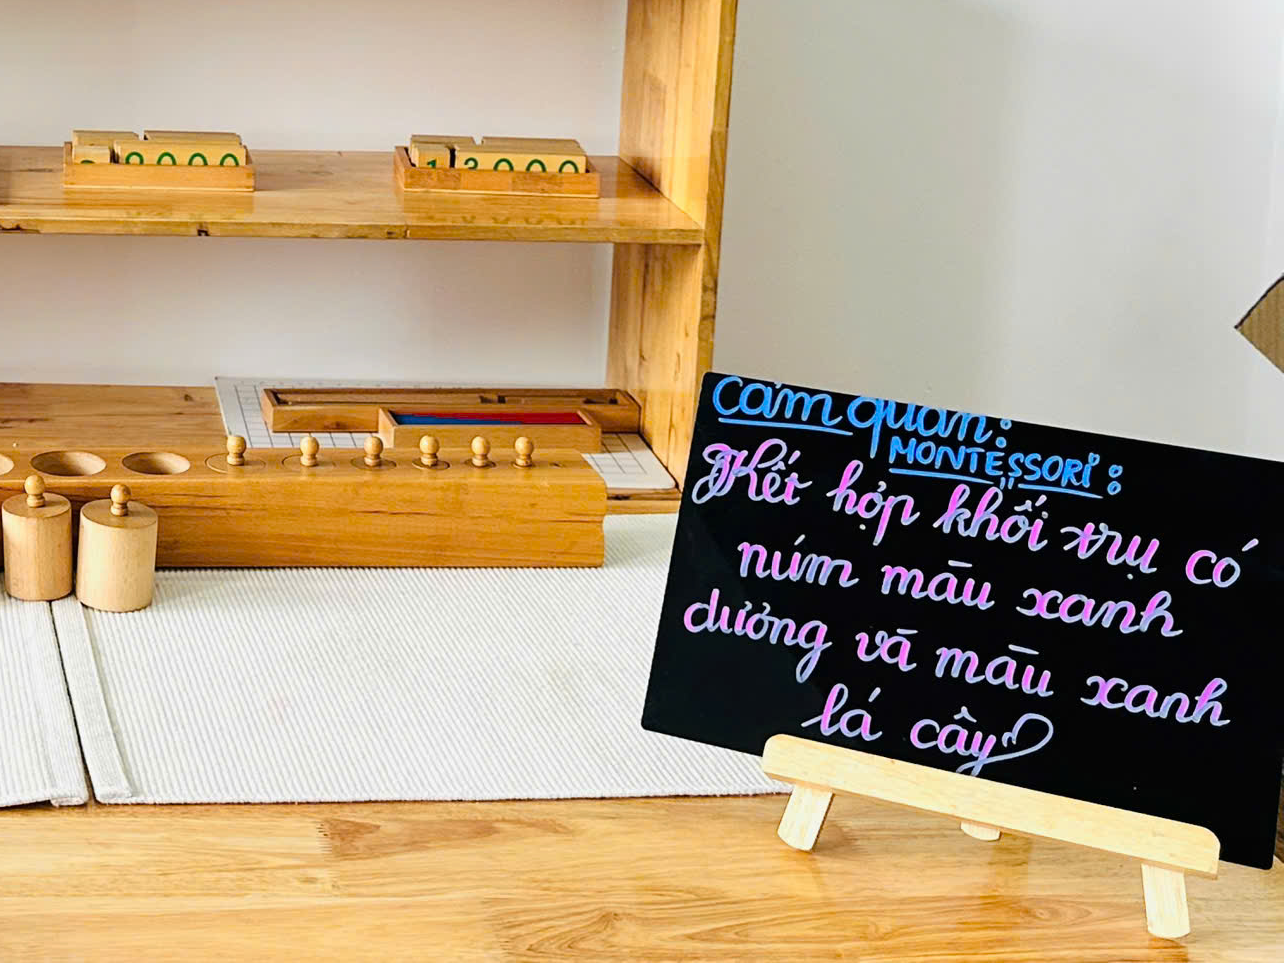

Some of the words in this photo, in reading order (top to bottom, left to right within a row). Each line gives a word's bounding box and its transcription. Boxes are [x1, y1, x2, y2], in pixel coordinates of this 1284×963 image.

[737, 534, 860, 587] núm
[1016, 588, 1183, 637] xanh
[1185, 538, 1259, 588] có
[801, 683, 882, 741] lá
[1080, 677, 1230, 726] xanh
